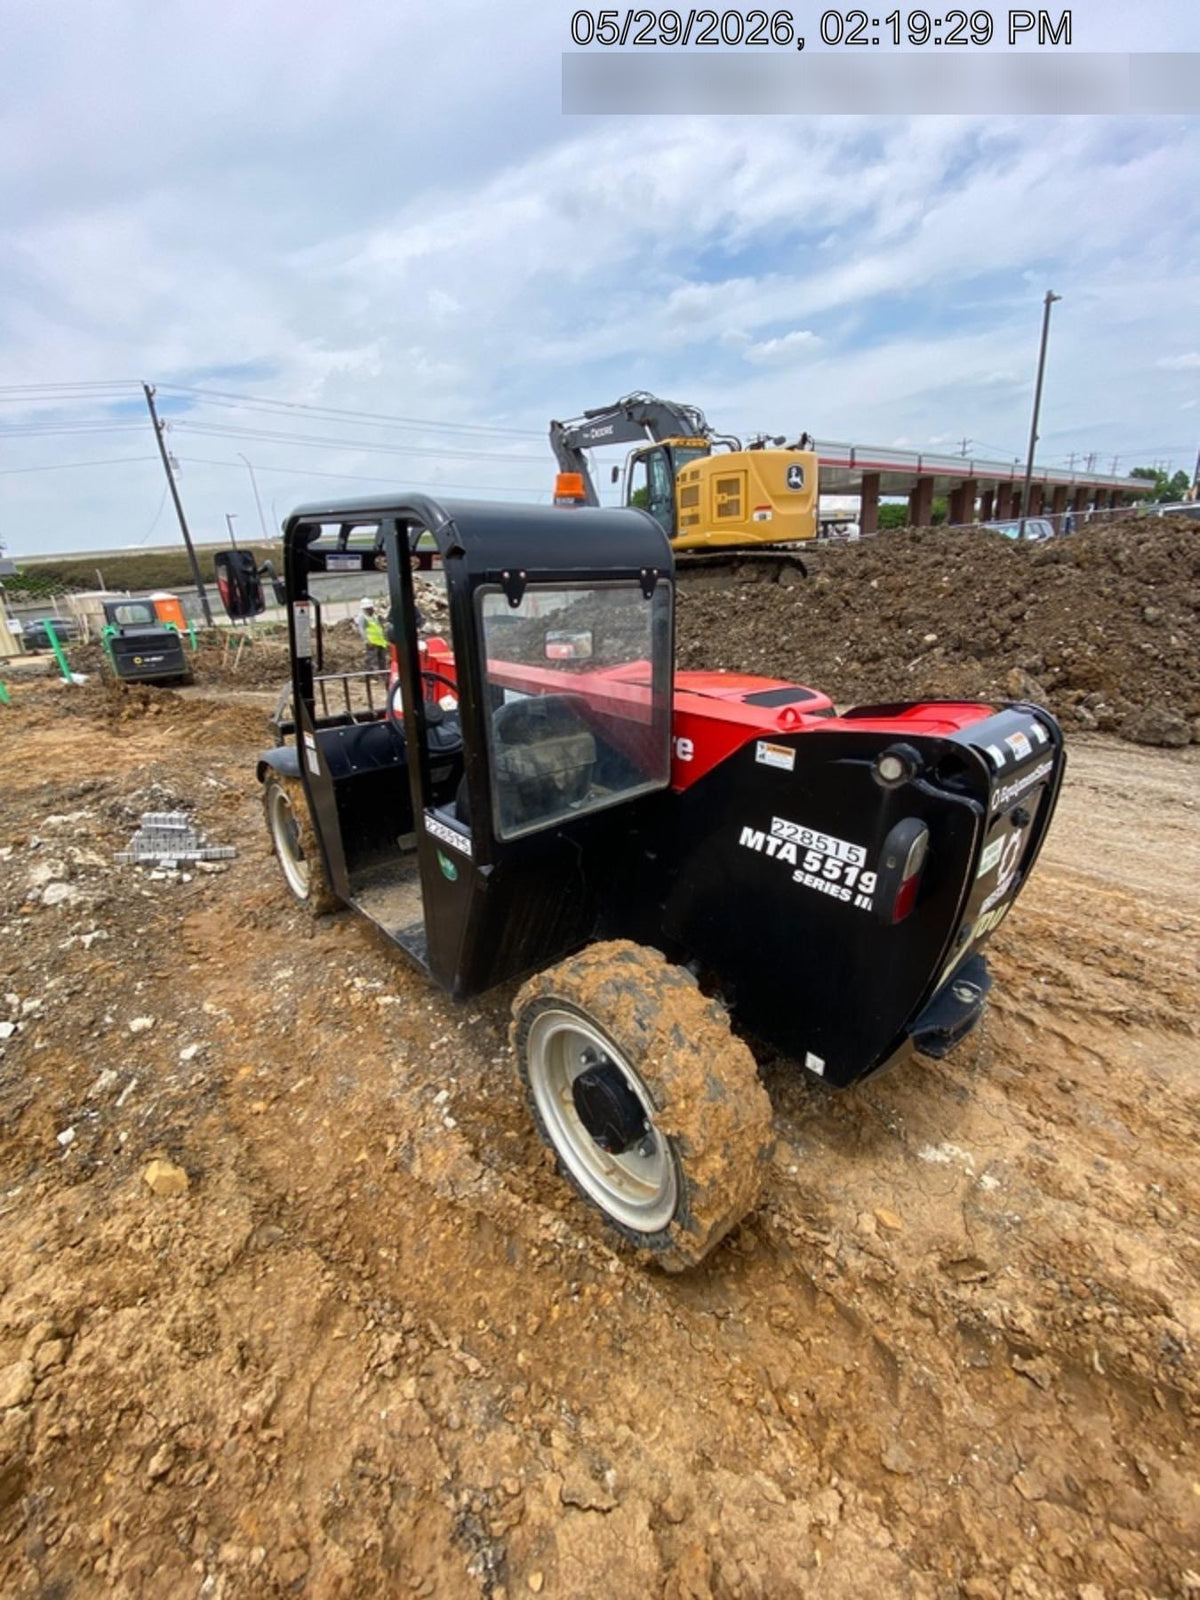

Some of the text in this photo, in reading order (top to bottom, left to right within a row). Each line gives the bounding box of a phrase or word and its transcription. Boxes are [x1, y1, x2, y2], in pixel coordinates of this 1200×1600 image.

[739, 826, 878, 894] MTA 5519
[772, 820, 862, 863] 228515
[792, 869, 852, 902] SERIES
